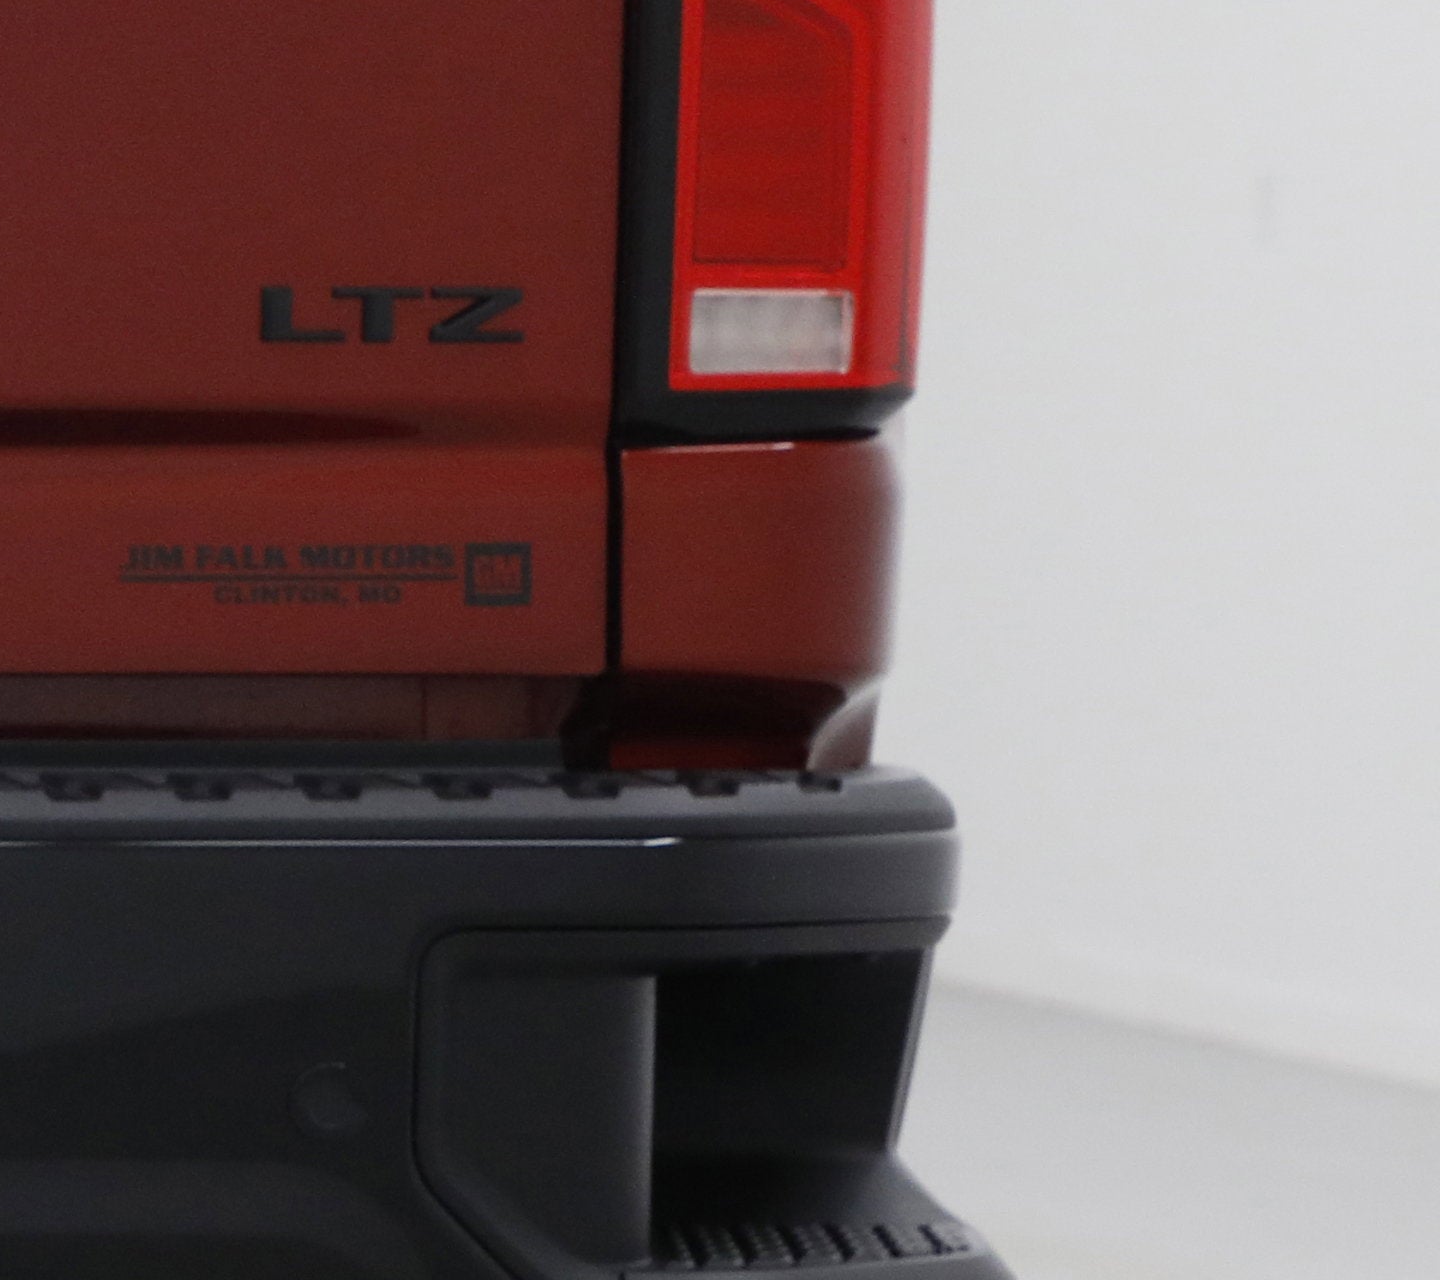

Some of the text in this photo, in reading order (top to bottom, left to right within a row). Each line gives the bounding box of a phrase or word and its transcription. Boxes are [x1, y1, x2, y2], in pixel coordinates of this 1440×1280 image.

[259, 285, 525, 344] LTZ
[123, 544, 456, 570] JIM FALK MOTORS
[359, 585, 402, 604] MO
